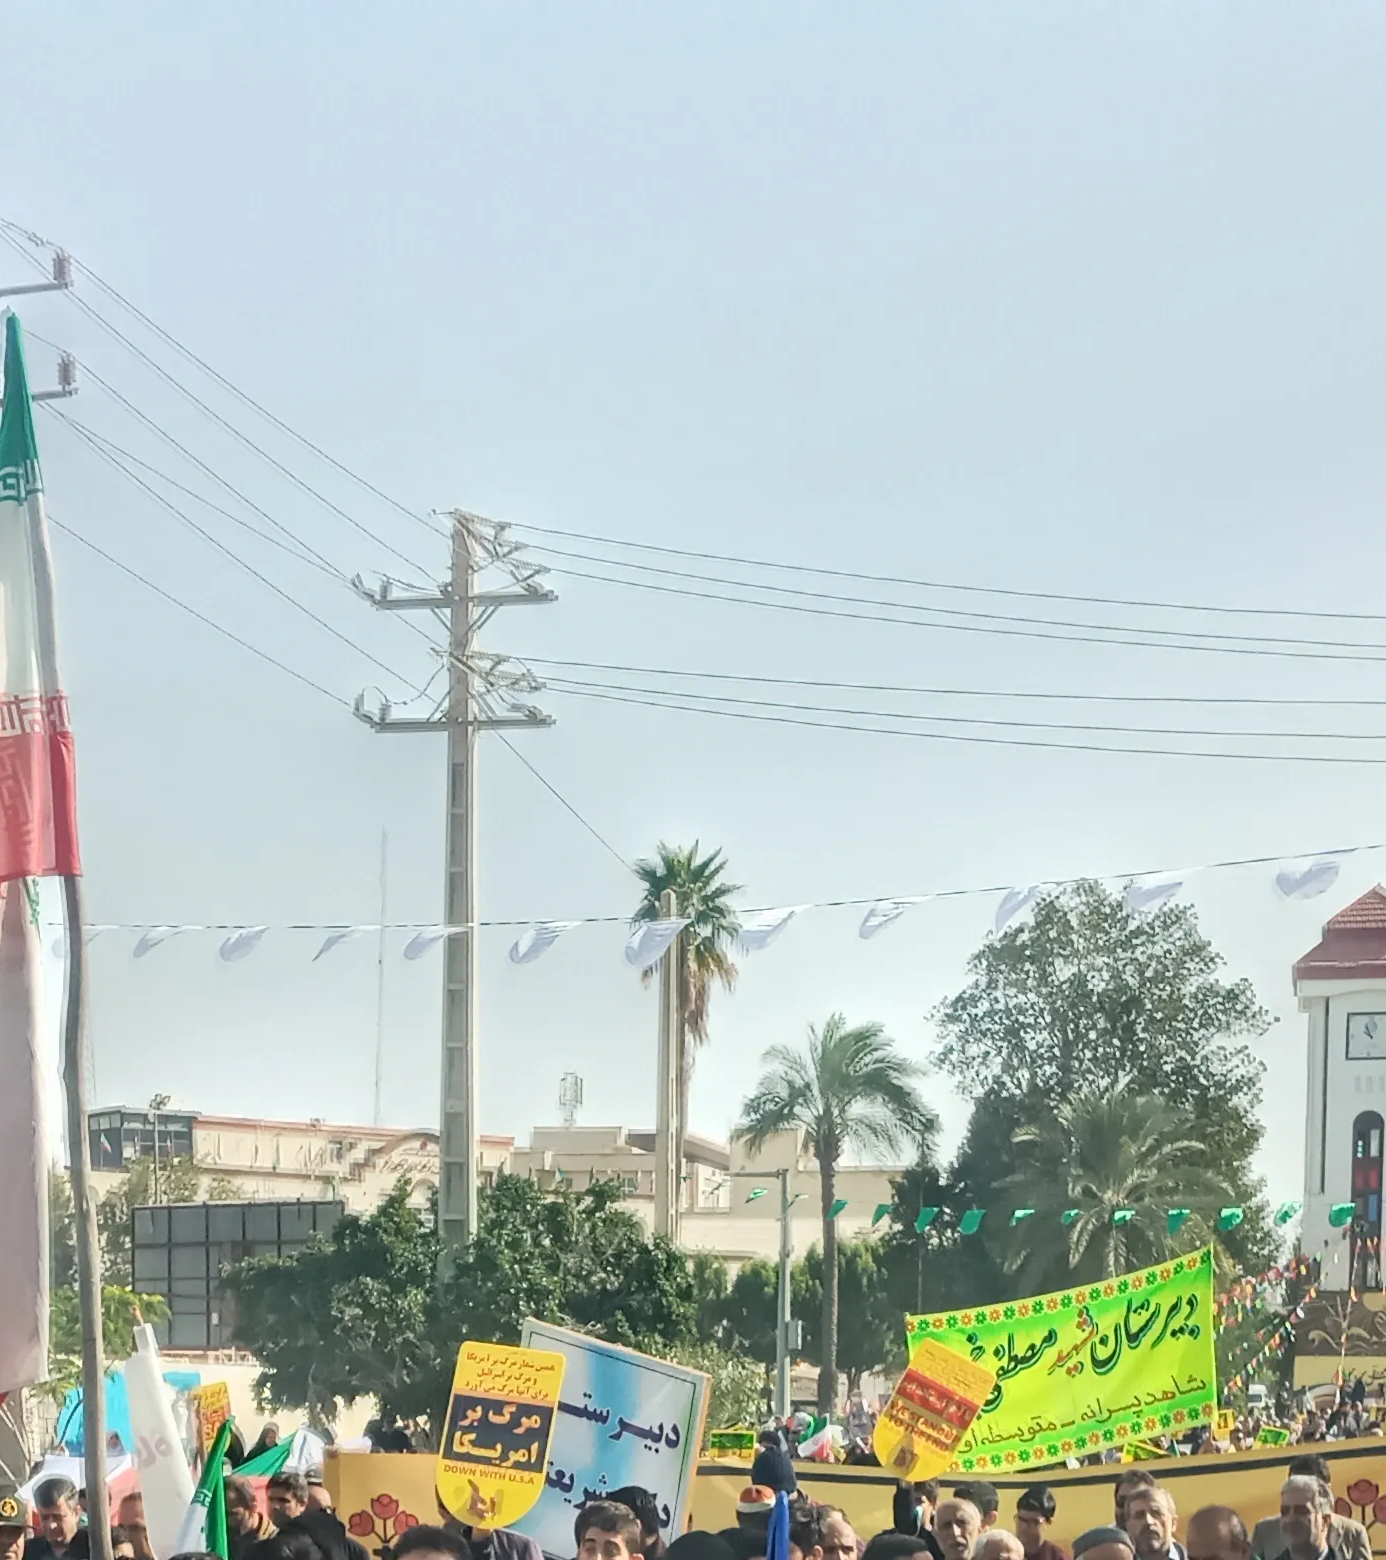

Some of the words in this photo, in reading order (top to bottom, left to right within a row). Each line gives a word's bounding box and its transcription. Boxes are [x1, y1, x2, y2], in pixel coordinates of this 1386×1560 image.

[1047, 1305, 1099, 1378] شهید
[1144, 1374, 1207, 1406] شاهد
[457, 1405, 483, 1427] بر
[488, 1404, 541, 1435] مرگ
[558, 1392, 681, 1454] دبیرست
[1080, 1395, 1143, 1423] پسرانه
[957, 1428, 979, 1454] او
[980, 1415, 1058, 1446] متوسطه
[444, 1464, 477, 1477] DOWN
[479, 1469, 507, 1480] WITH
[509, 1473, 535, 1485] U.S.A
